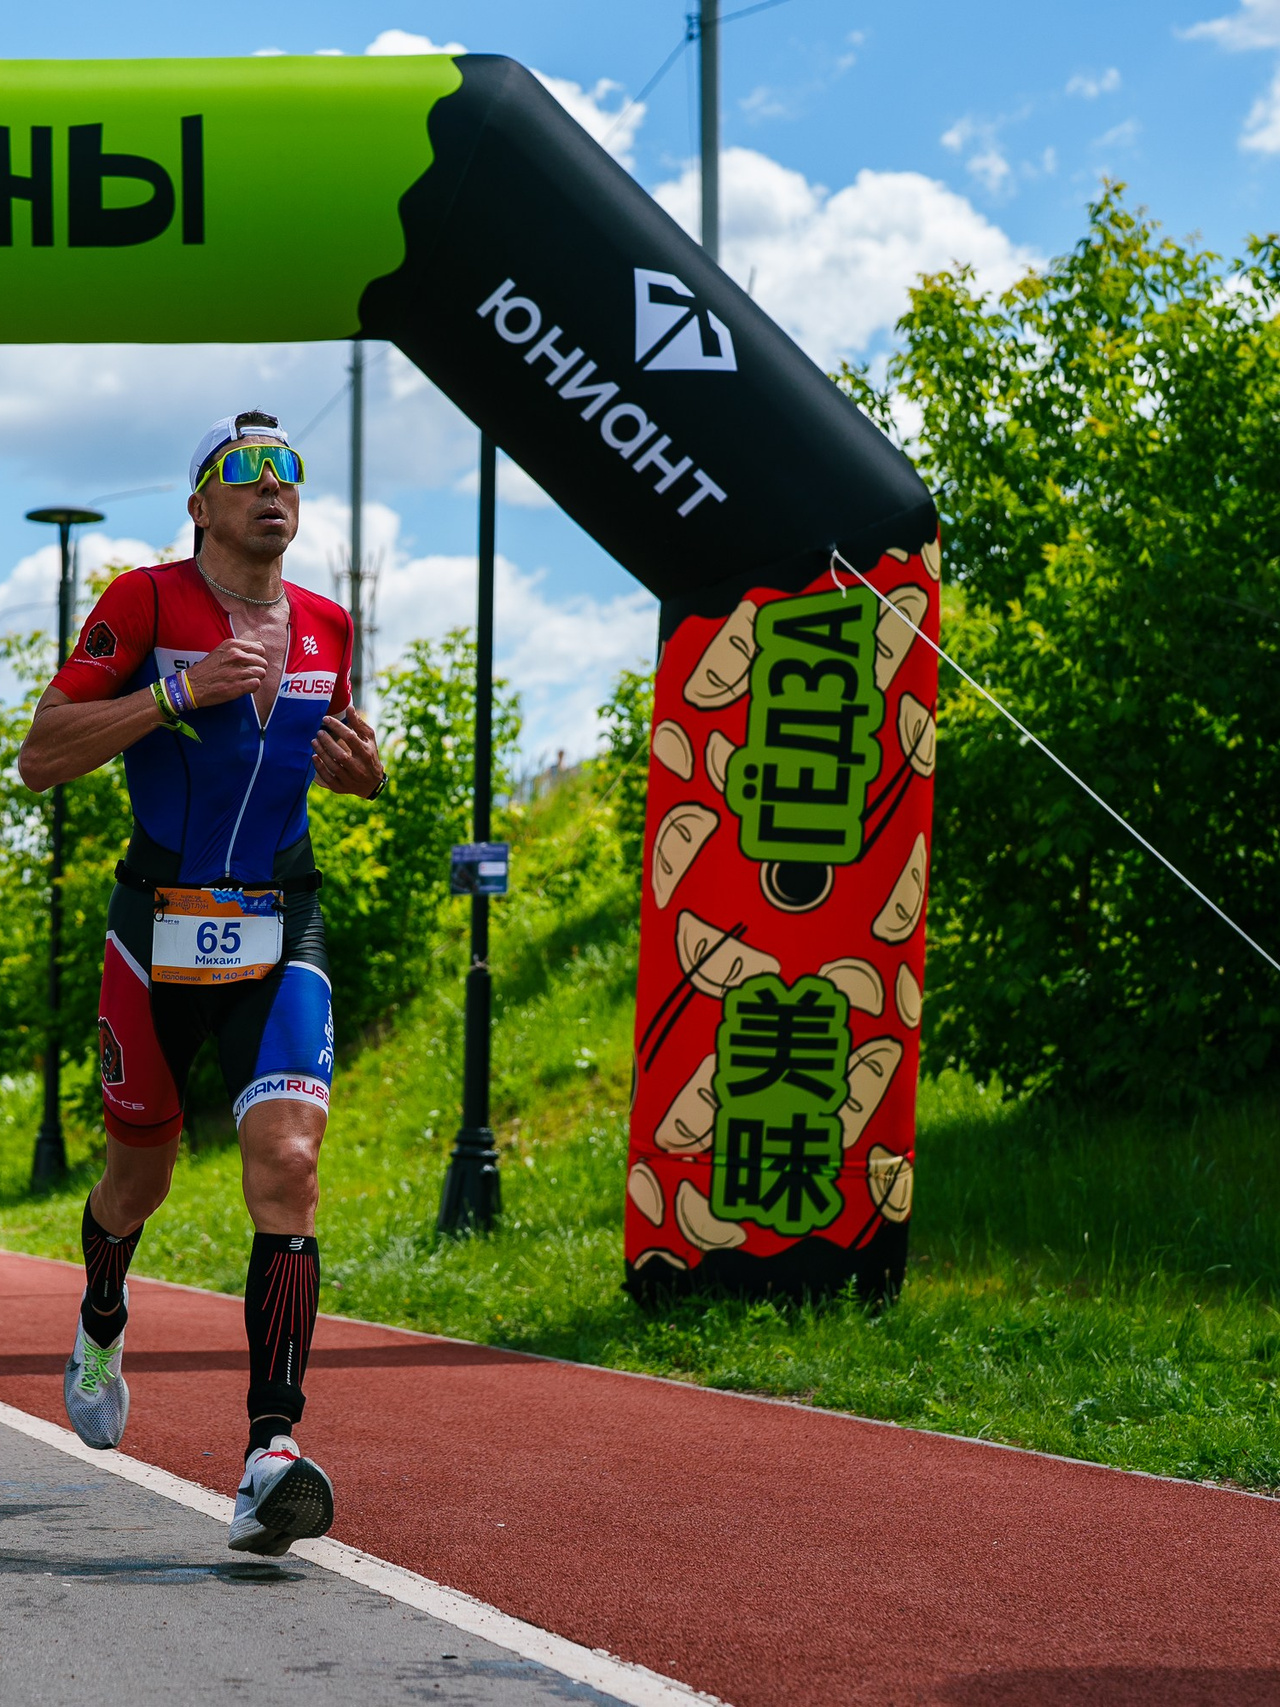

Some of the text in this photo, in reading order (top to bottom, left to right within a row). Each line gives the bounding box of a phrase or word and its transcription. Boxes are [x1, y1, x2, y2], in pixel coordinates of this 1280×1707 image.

[742, 604, 869, 846] ГЁДЗА
[195, 954, 241, 965] Михаил
[196, 921, 241, 954] 65
[723, 987, 839, 1222] 美味
